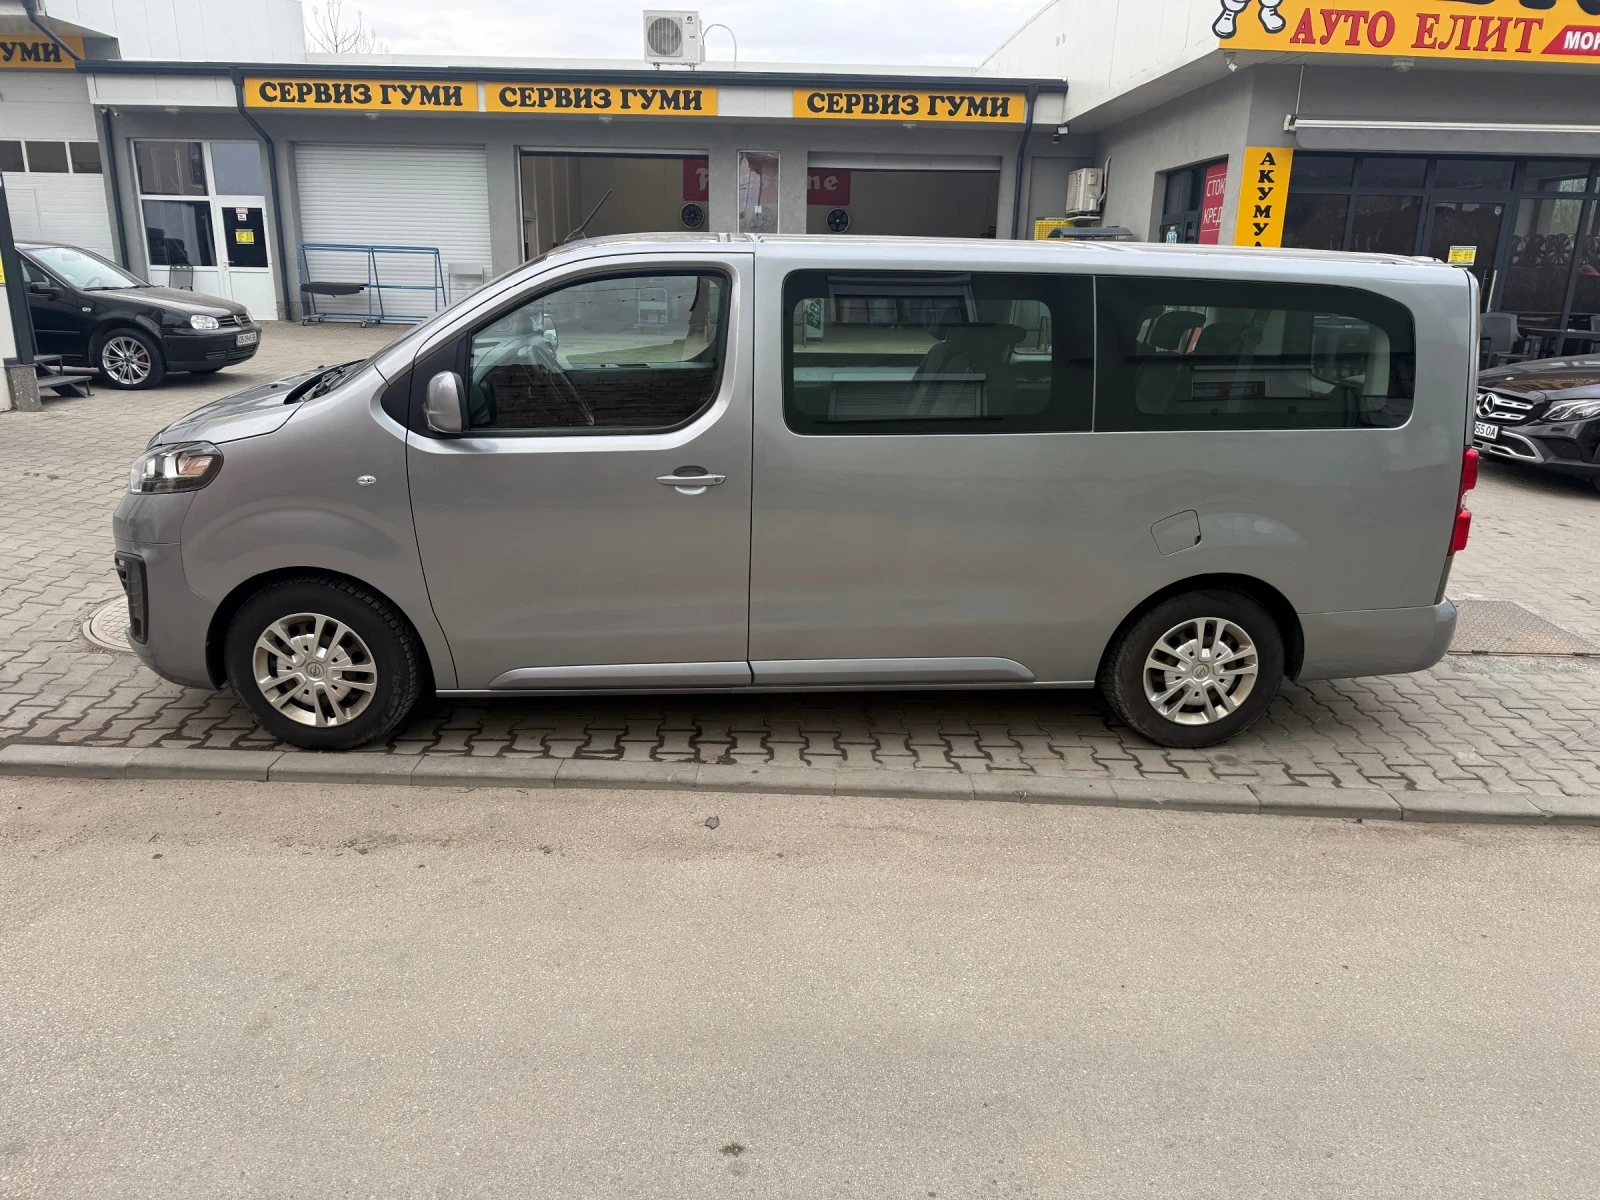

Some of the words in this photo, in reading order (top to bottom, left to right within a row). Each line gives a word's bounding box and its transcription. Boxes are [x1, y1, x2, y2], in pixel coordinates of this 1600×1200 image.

[1289, 8, 1396, 48] АУТО
[1411, 13, 1544, 53] ЕЛИТ
[258, 81, 372, 104] СЕРВИЗ
[379, 84, 464, 107] ГУМИ
[498, 86, 612, 109] СЕРВИЗ
[620, 88, 703, 111] ГУМИ
[806, 92, 920, 115] СЕРВИЗ
[927, 95, 1011, 117] ГУМИ
